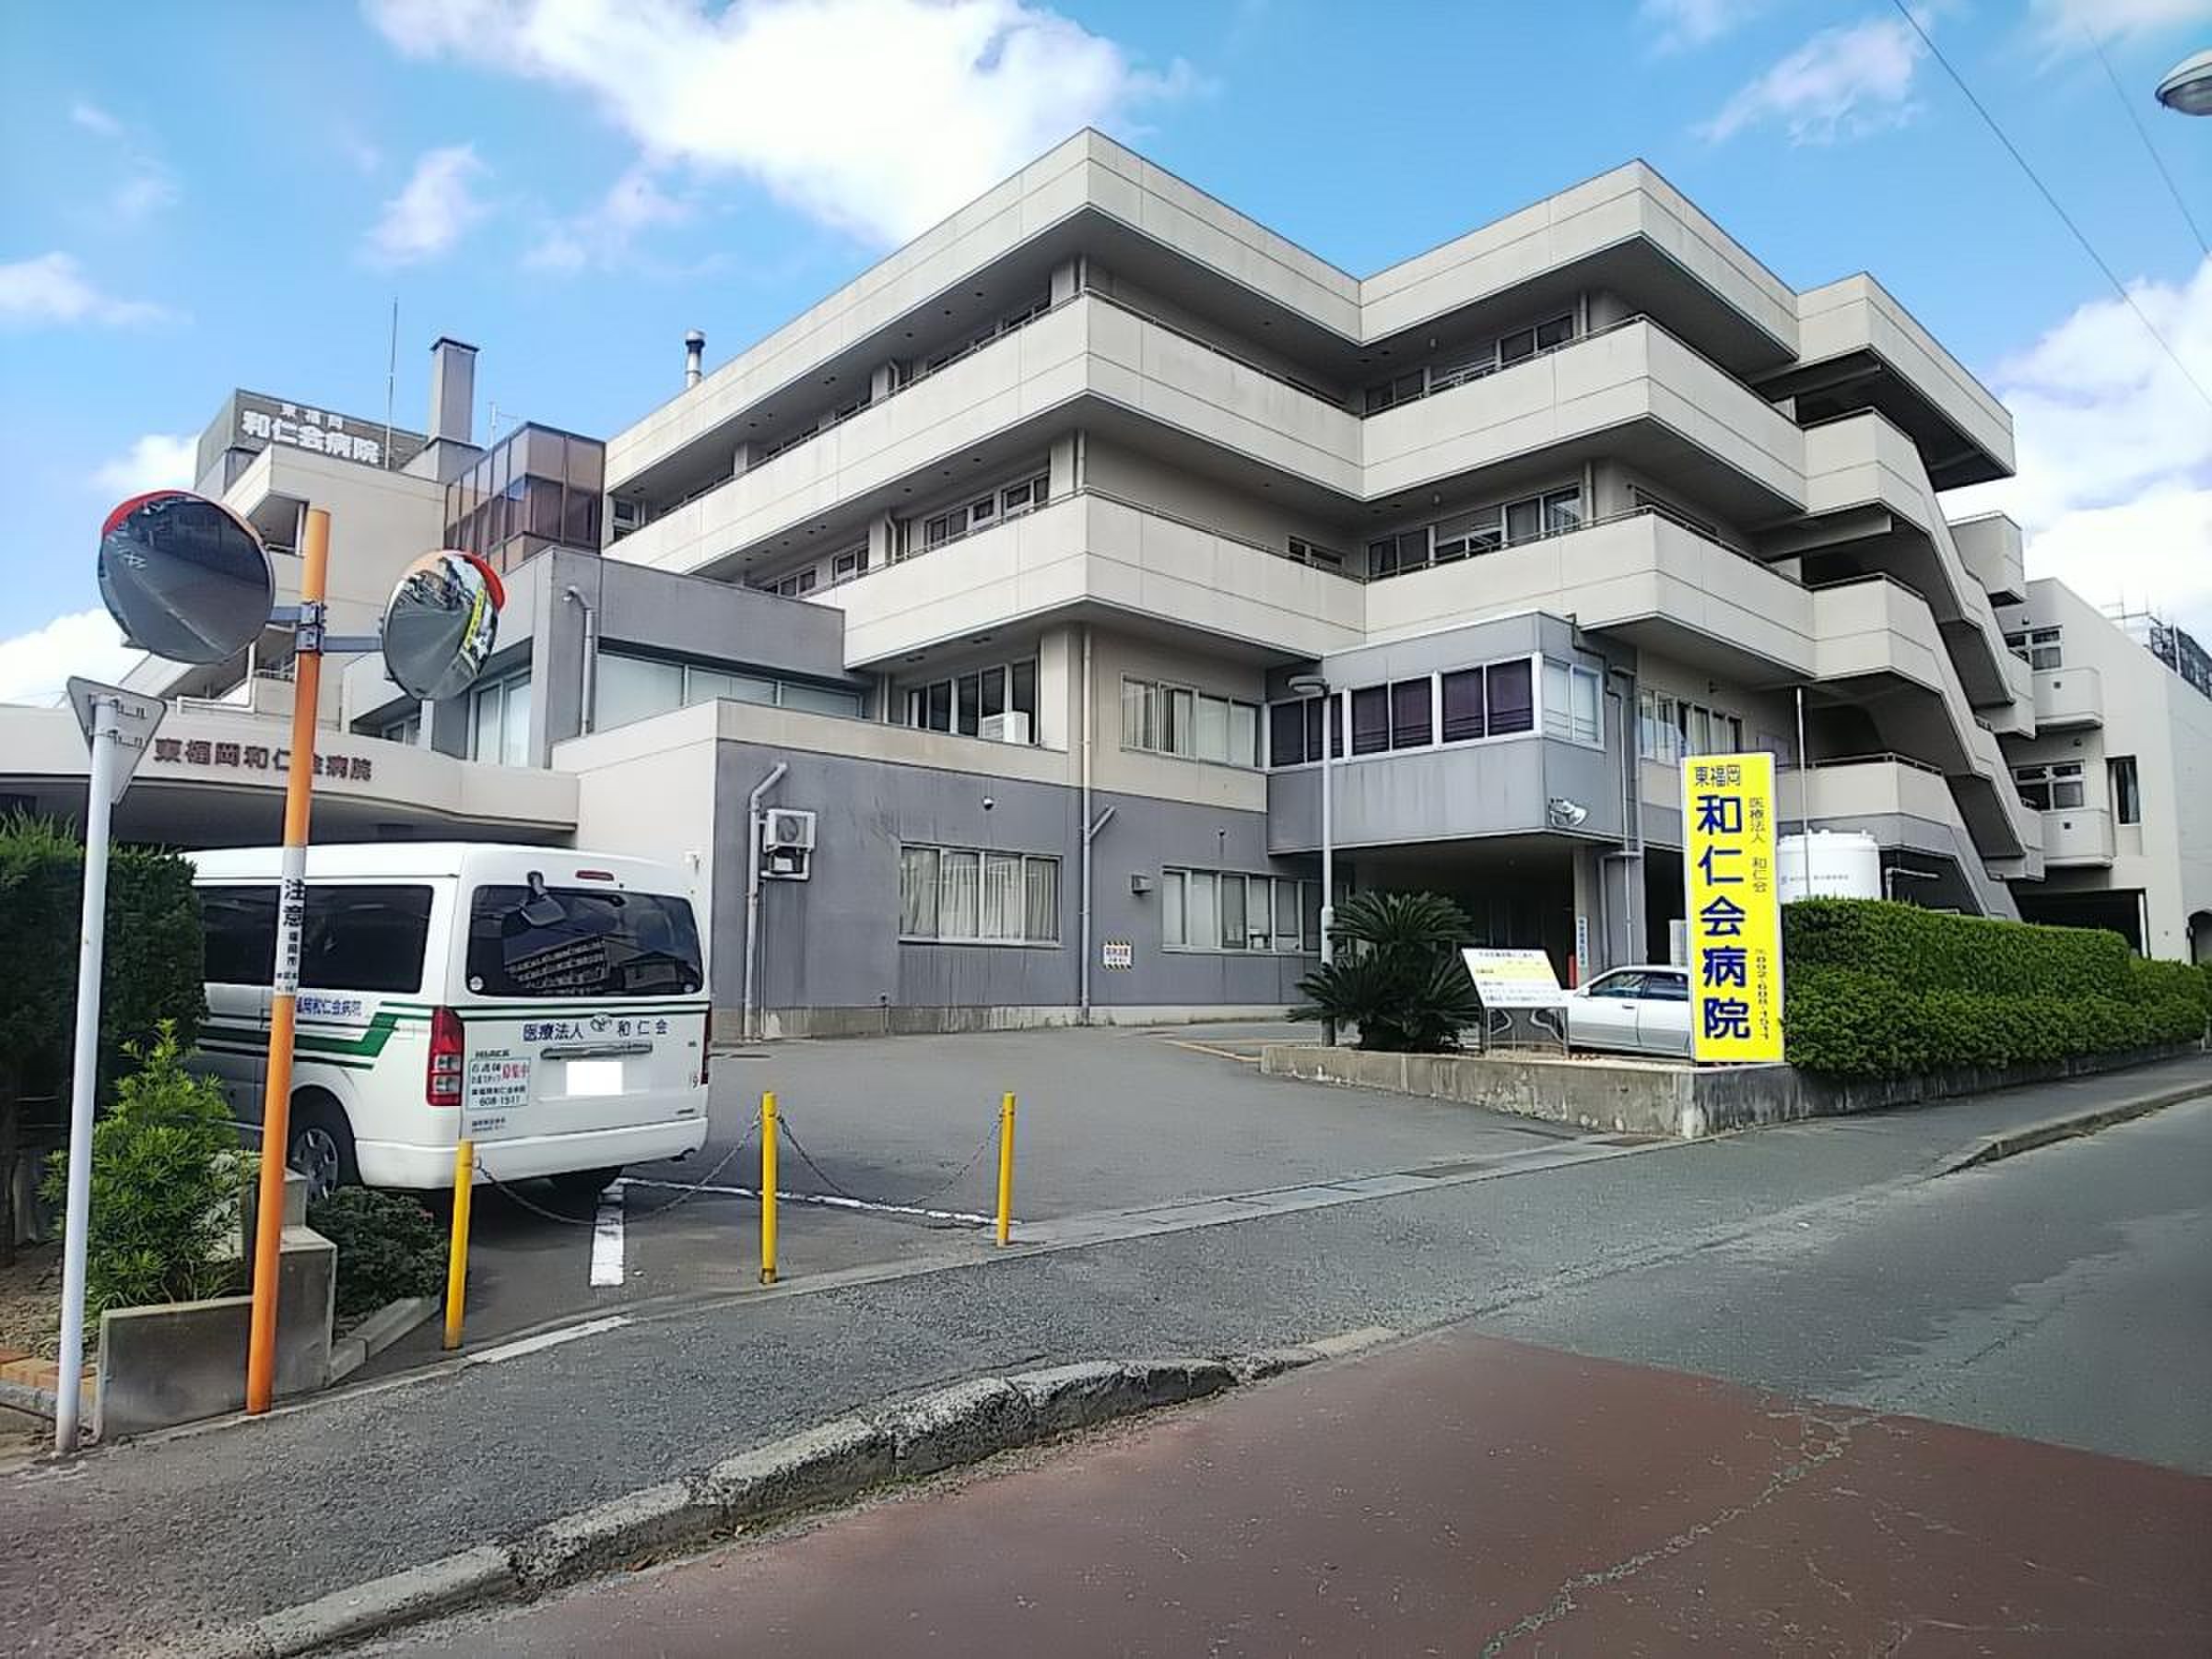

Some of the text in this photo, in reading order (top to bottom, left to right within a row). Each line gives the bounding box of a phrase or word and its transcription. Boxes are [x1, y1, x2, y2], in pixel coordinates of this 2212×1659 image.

[241, 411, 379, 463] 和仁会病院
[1694, 764, 1741, 787] 東福岡
[283, 878, 305, 927] 注意
[1695, 794, 1750, 1039] 和仁会病院
[523, 1018, 669, 1042] 医療法人 和仁会
